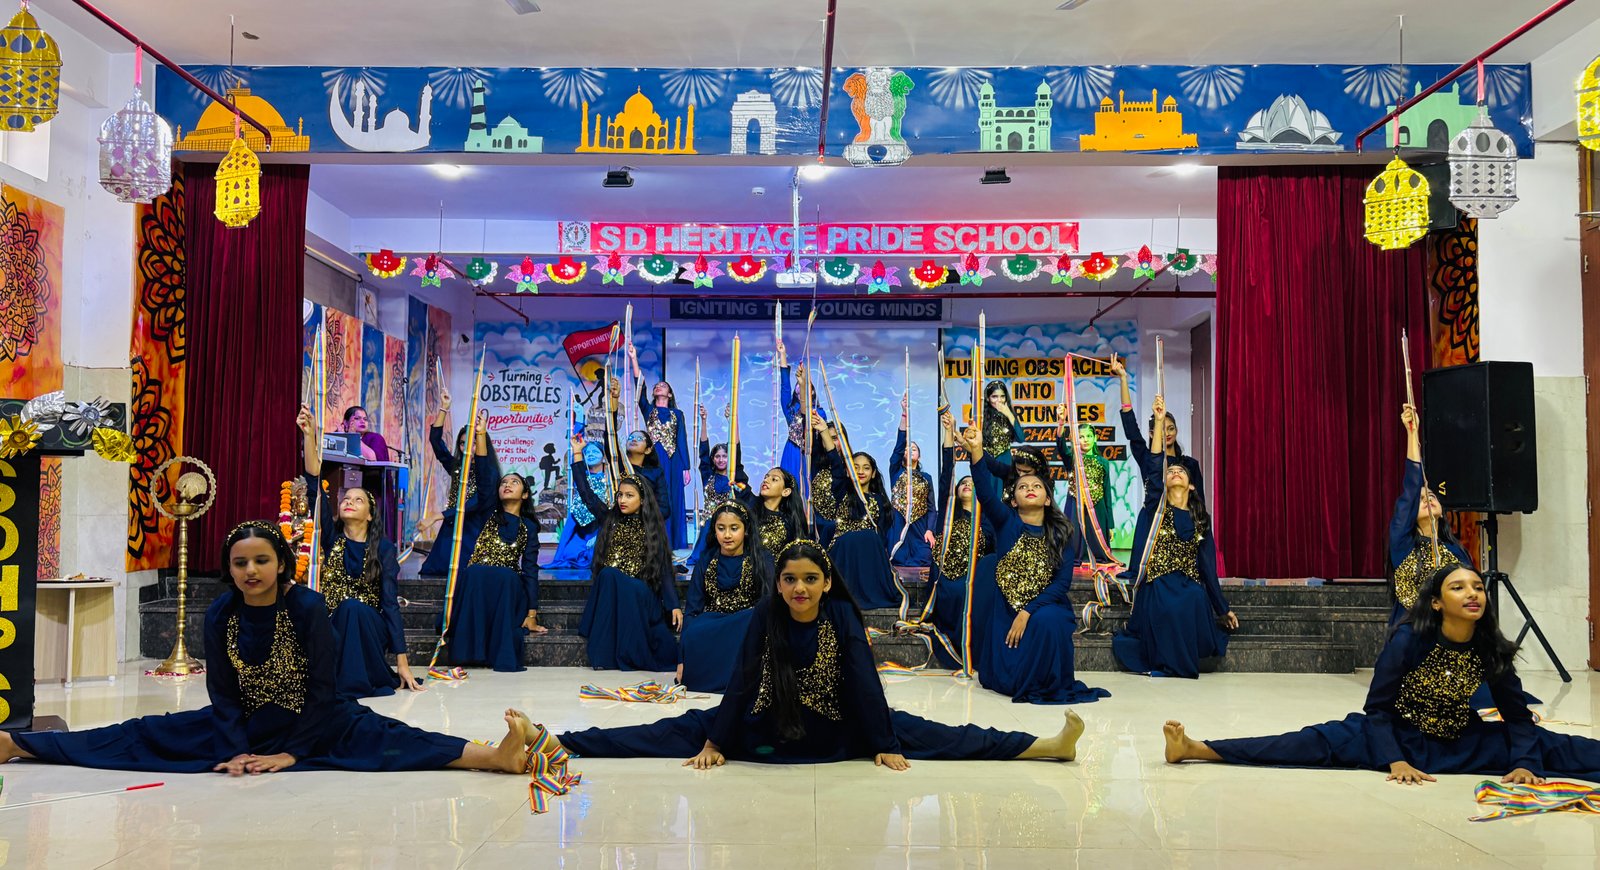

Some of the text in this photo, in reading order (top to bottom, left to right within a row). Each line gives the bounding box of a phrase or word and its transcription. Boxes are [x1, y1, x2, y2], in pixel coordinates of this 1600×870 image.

[655, 226, 817, 251] HERITAGE
[827, 226, 924, 251] PRIDE
[933, 226, 1073, 251] SCHOOL
[680, 301, 757, 315] IGNITING
[499, 369, 542, 385] Turning
[480, 384, 561, 404] OBSTACLES
[1014, 382, 1053, 399] INTO
[495, 446, 528, 454] arries the
[503, 438, 535, 448] challenge
[499, 455, 536, 465] of growth
[1102, 445, 1124, 460] OF
